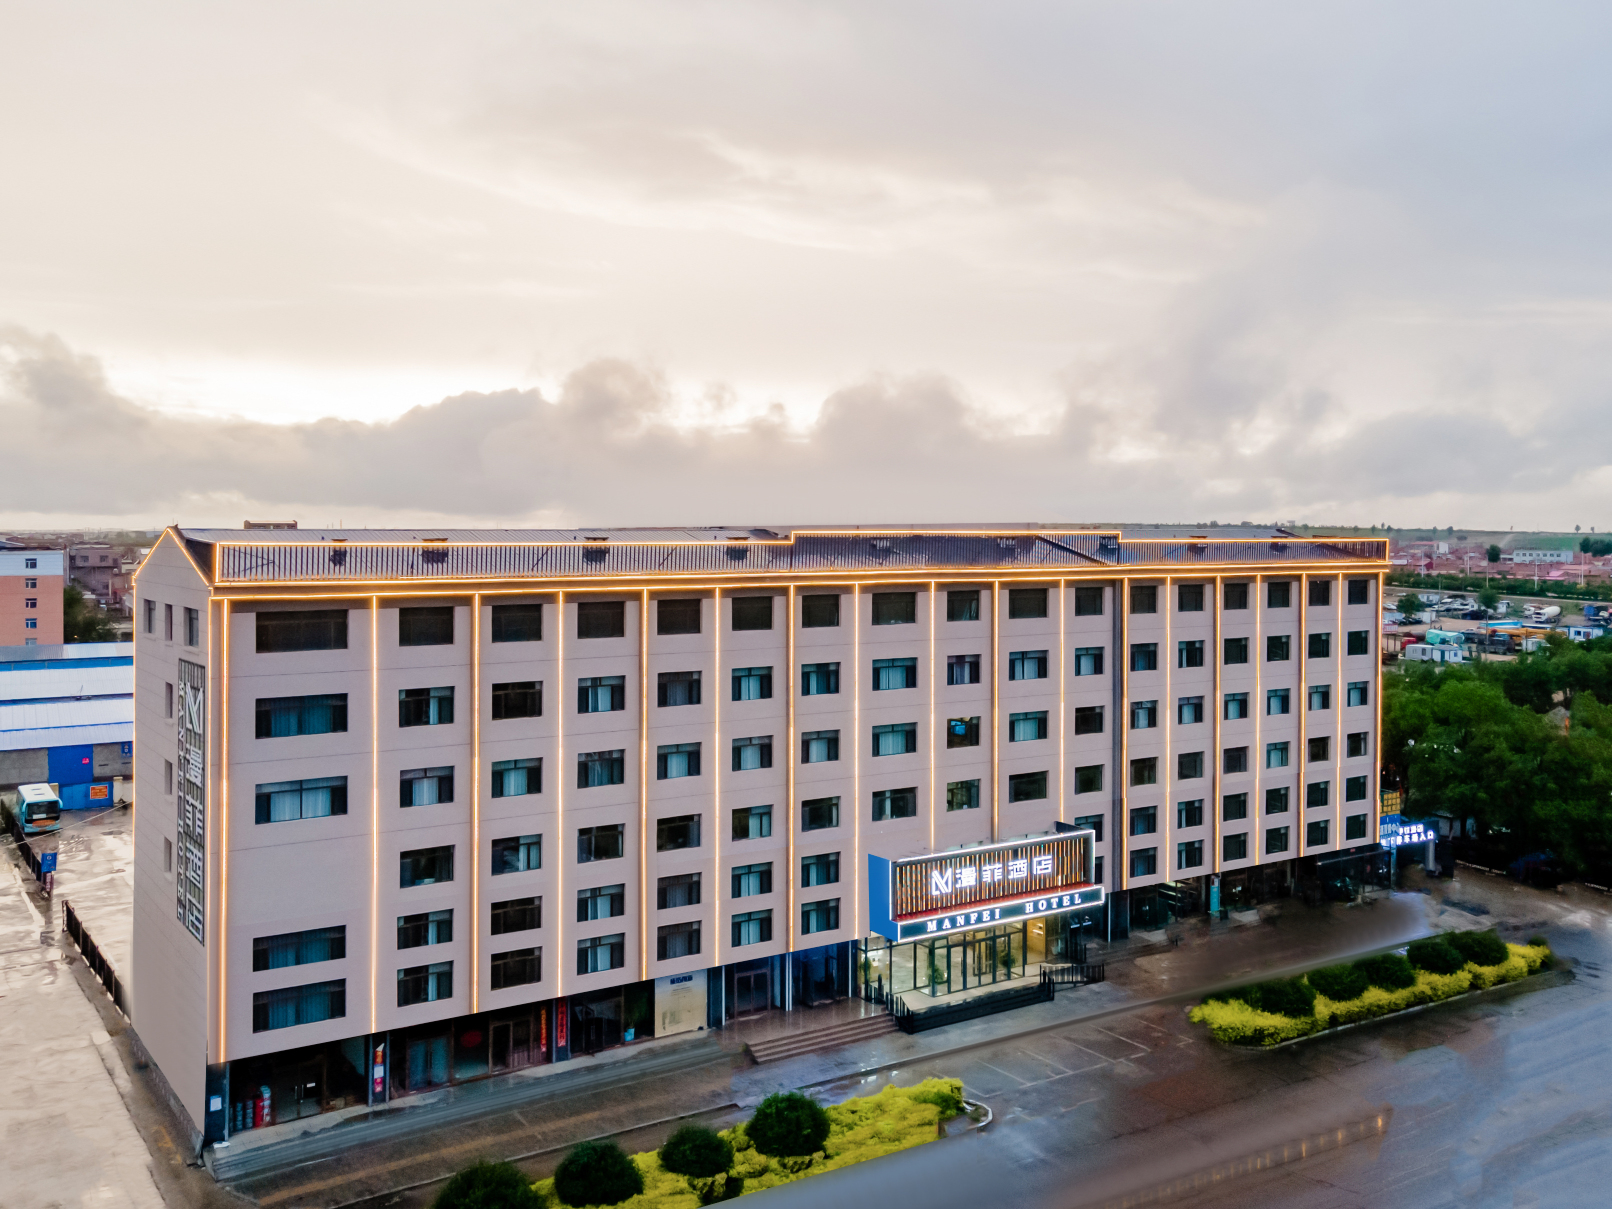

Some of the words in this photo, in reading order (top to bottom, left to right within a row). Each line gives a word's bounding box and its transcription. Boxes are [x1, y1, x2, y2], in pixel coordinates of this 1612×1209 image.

[185, 743, 204, 943] 漫菲酒店
[955, 855, 1053, 889] 漫菲酒店
[927, 908, 1001, 933] MANFEI
[1025, 893, 1082, 914] HOTEL
